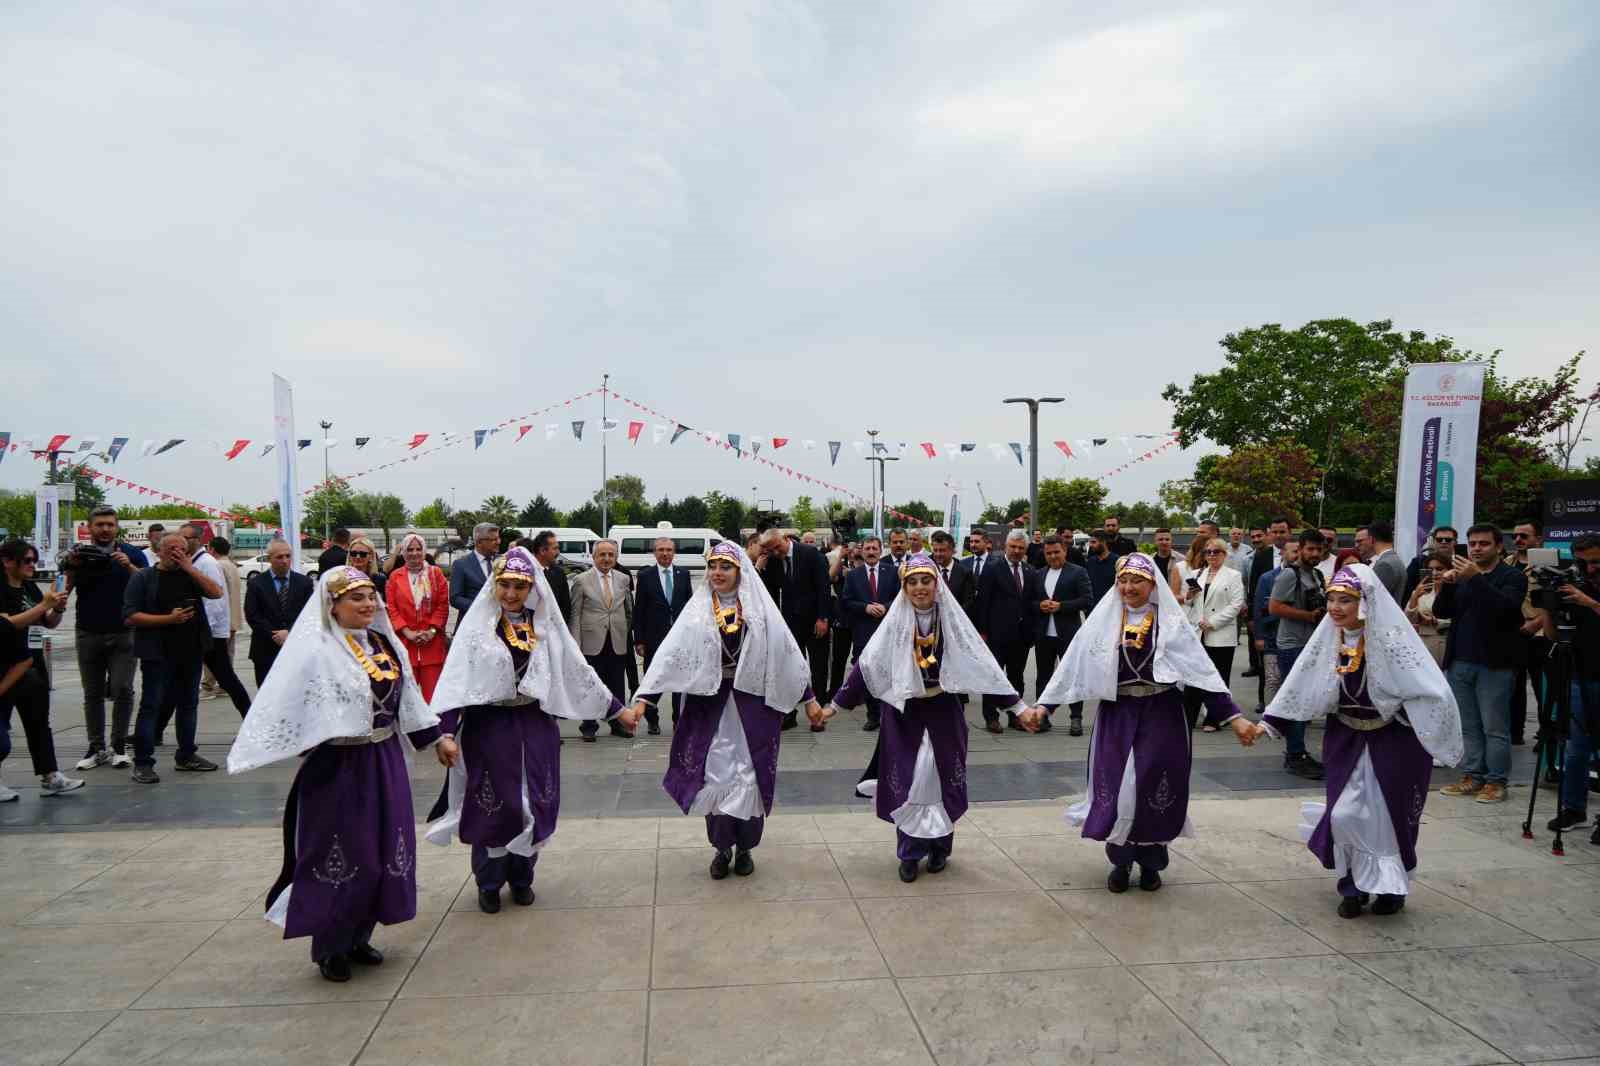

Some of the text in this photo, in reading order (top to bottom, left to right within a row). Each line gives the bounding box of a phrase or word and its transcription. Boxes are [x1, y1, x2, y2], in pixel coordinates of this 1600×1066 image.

[1423, 426, 1436, 501] Kültür Yolu Festivali
